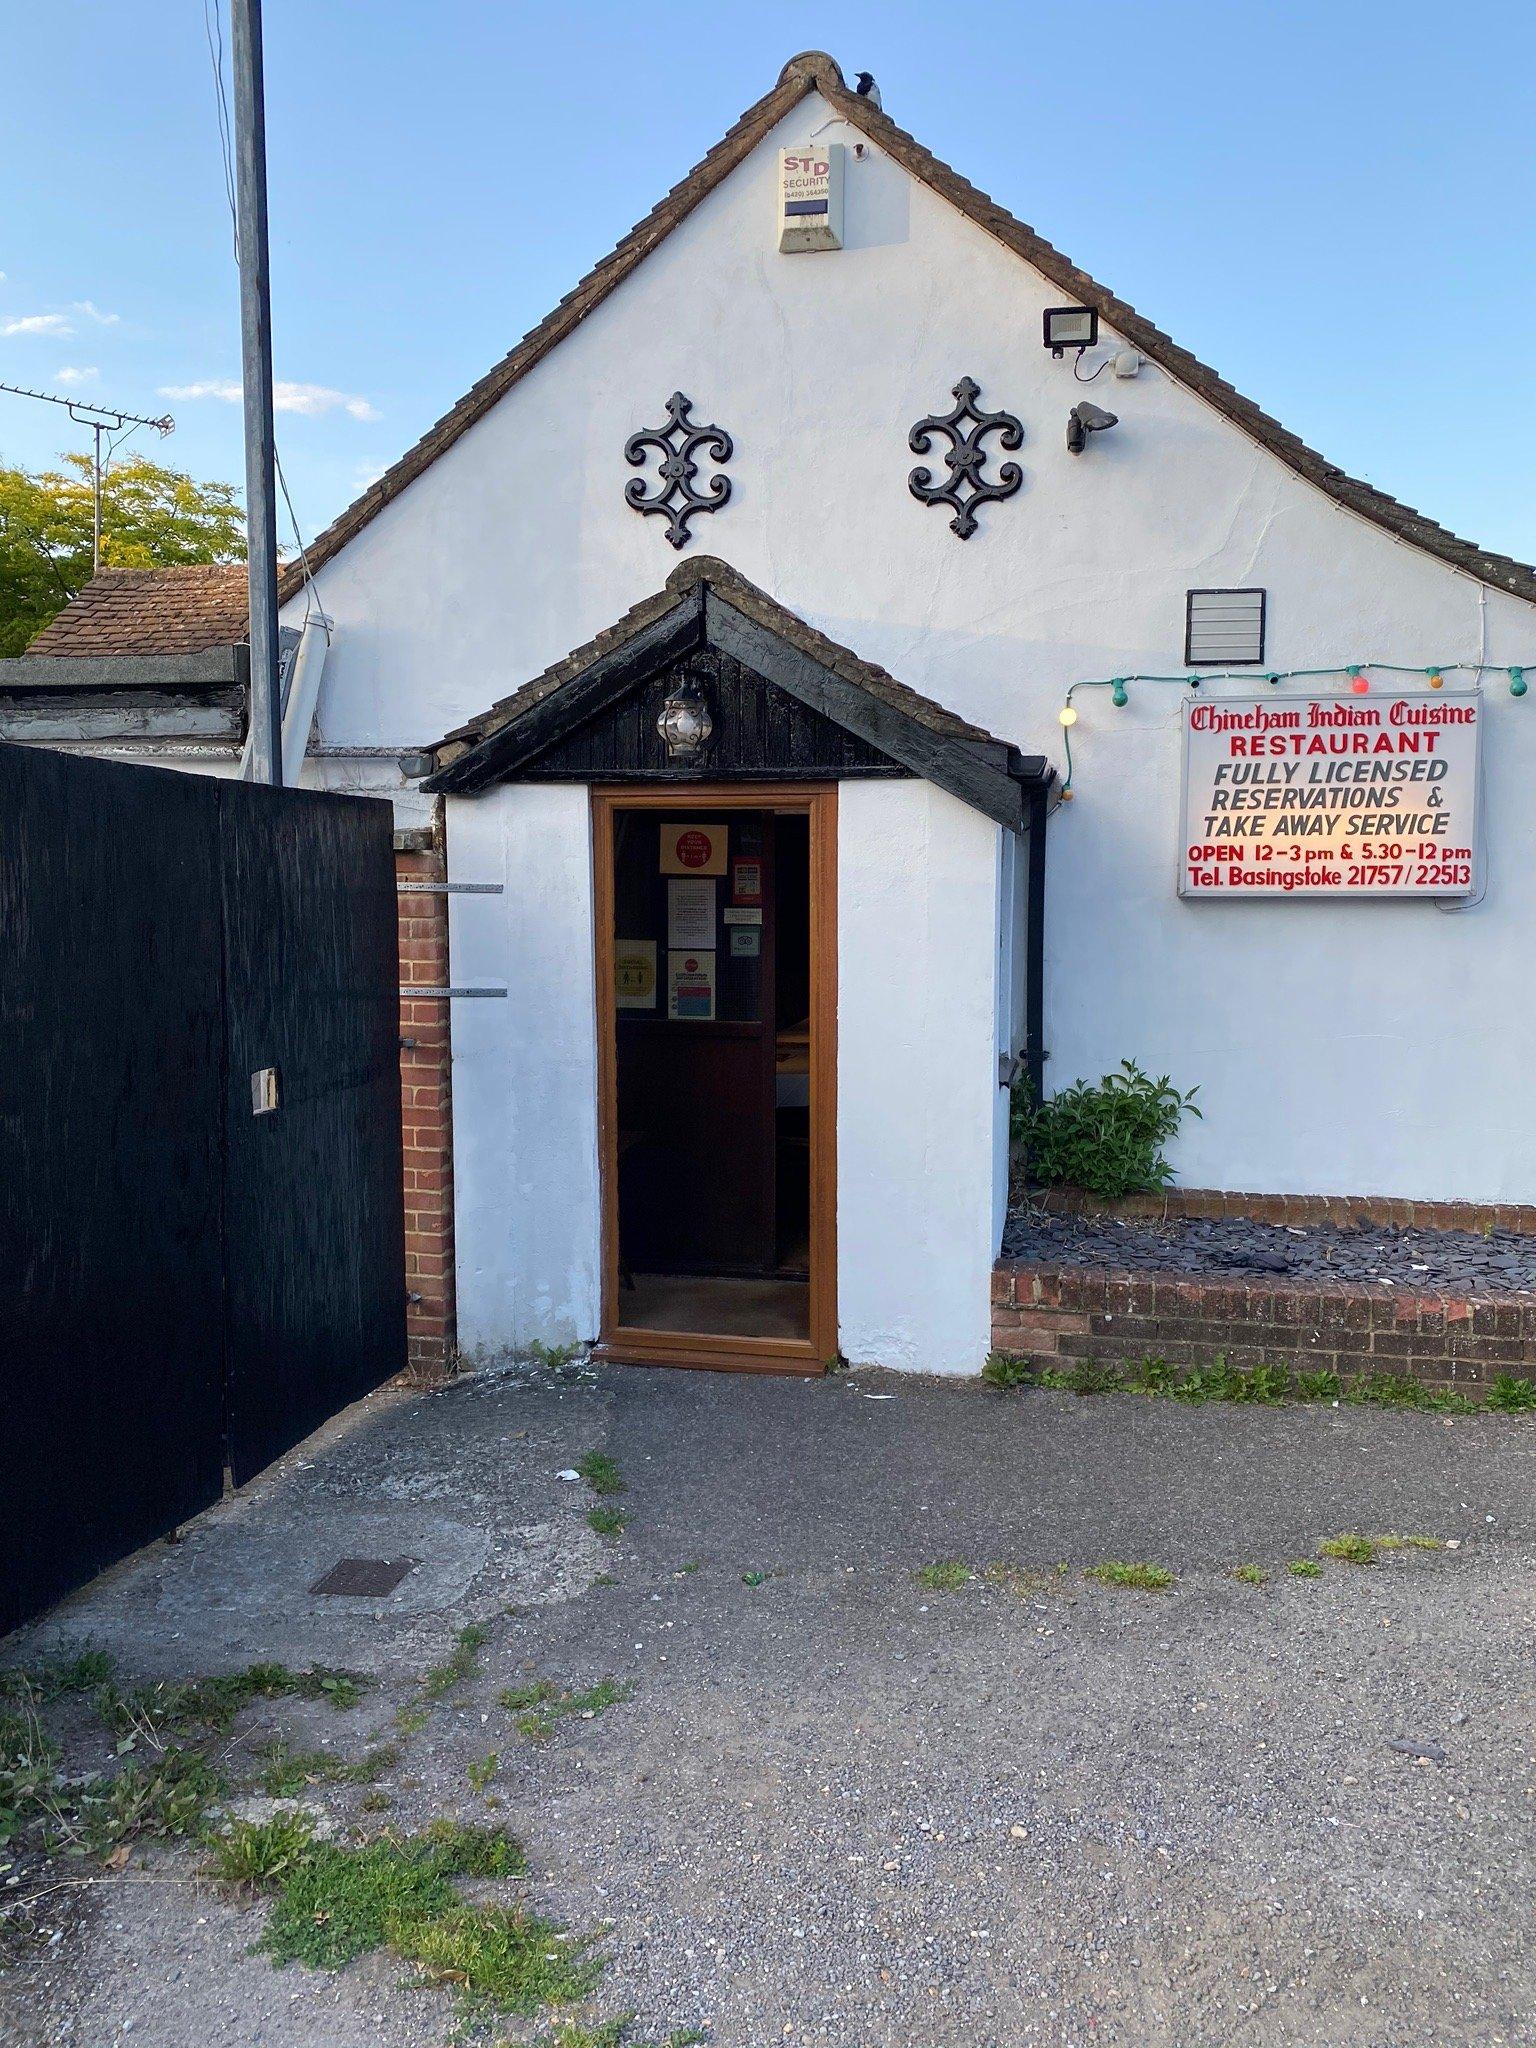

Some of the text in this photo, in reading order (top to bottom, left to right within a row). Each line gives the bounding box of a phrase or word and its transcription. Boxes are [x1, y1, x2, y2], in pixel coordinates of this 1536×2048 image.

[784, 157, 829, 175] STD
[783, 176, 830, 189] SECURITY
[1190, 700, 1476, 734] Chineham Indian Cuisine
[1230, 731, 1440, 757] RESTAURANT
[1214, 759, 1448, 786] FULLY LICENSED
[1211, 785, 1443, 811] RESERVATIONS &
[1204, 812, 1450, 837] TAKE AWAY SERVICE
[1188, 845, 1244, 862] OPEN
[1340, 843, 1353, 860] &
[1188, 866, 1224, 886] Tel.
[1228, 865, 1342, 891] Basingstoke
